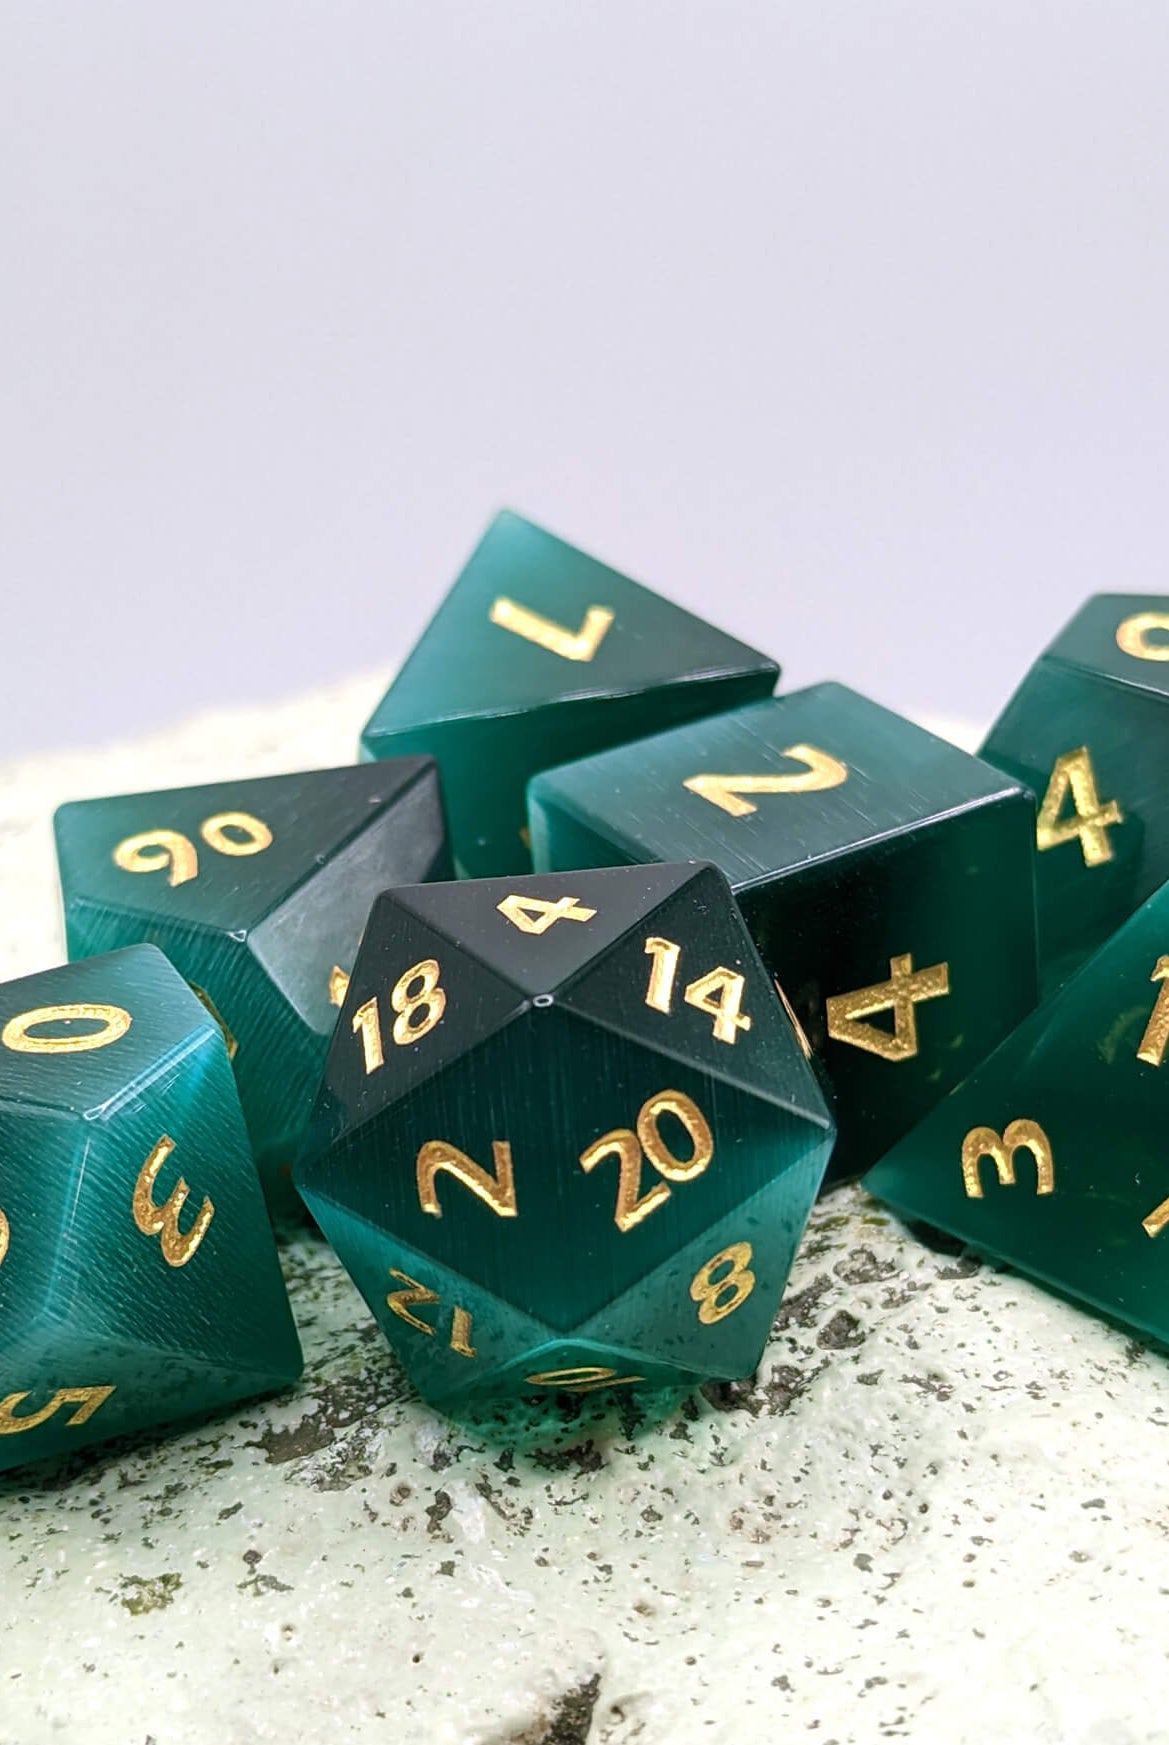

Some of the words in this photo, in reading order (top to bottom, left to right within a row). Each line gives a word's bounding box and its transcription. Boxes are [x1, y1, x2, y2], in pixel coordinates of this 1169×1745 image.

[684, 745, 848, 818] 2
[1036, 747, 1121, 866] 4
[114, 811, 273, 886] 90
[497, 893, 596, 936] 4
[1, 1003, 131, 1054] 0
[351, 958, 447, 1075] 18
[644, 937, 752, 1044] 14
[826, 954, 950, 1062] 4
[416, 1140, 518, 1219] 2
[579, 1089, 714, 1233] 20
[960, 1118, 1054, 1200] 3
[131, 1134, 214, 1269] 3
[690, 1242, 757, 1326] 8
[0, 1385, 117, 1435] 5
